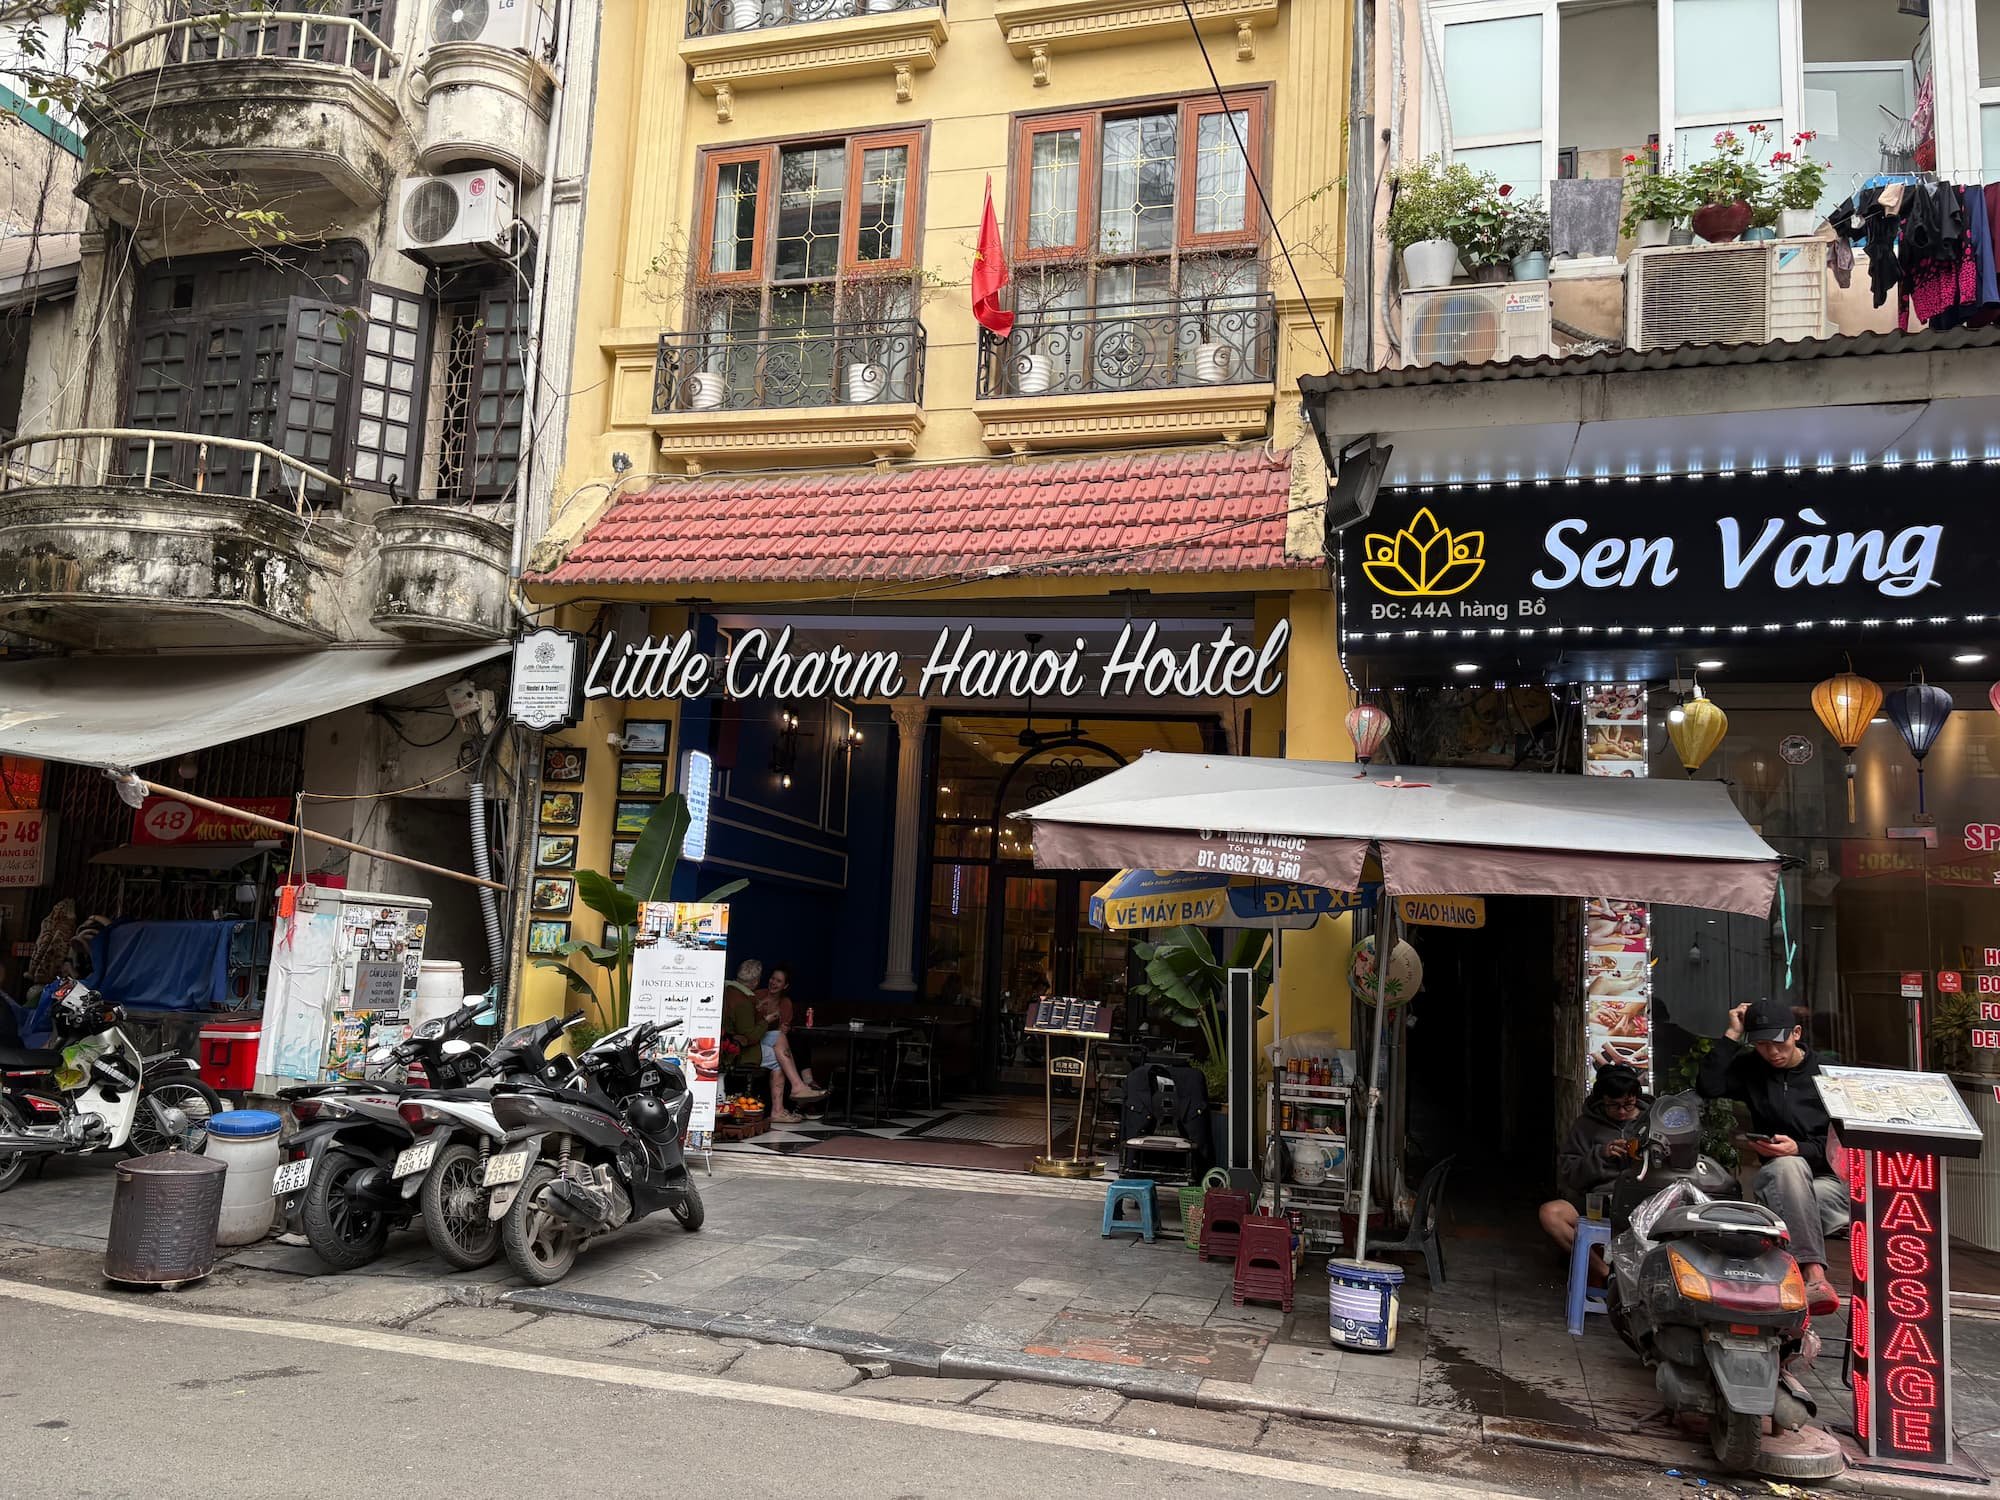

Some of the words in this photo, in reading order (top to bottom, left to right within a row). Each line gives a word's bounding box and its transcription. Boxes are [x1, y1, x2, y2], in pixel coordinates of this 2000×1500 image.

[1532, 518, 1679, 590] Sen
[1716, 508, 1945, 598] Vàng
[1371, 603, 1407, 619] ĐC:
[1411, 602, 1452, 618] 44A
[1460, 601, 1508, 620] hàng
[583, 628, 709, 700] Little
[725, 624, 904, 700] Charm
[919, 624, 1087, 699] Hanoi
[1100, 618, 1291, 698] Hostel
[151, 811, 187, 830] 48
[14, 821, 40, 843] 48
[1226, 831, 1265, 845] MINH
[1267, 834, 1307, 853] NGỌC
[1197, 850, 1217, 868] ĐT:
[1219, 853, 1250, 873] 0362
[1252, 856, 1275, 876] 794
[1277, 860, 1301, 880] 560
[1263, 885, 1320, 915] ĐẶT
[1327, 887, 1364, 909] XE
[1405, 901, 1439, 920] GIAO
[1116, 902, 1137, 926] VÉ
[1141, 899, 1177, 923] MÁY
[1181, 899, 1216, 921] BAY
[641, 979, 673, 988] HOSTEL
[675, 980, 715, 989] SERVICES
[1723, 1269, 1763, 1279] HONDA
[1877, 1151, 1936, 1452] MASSAGE
